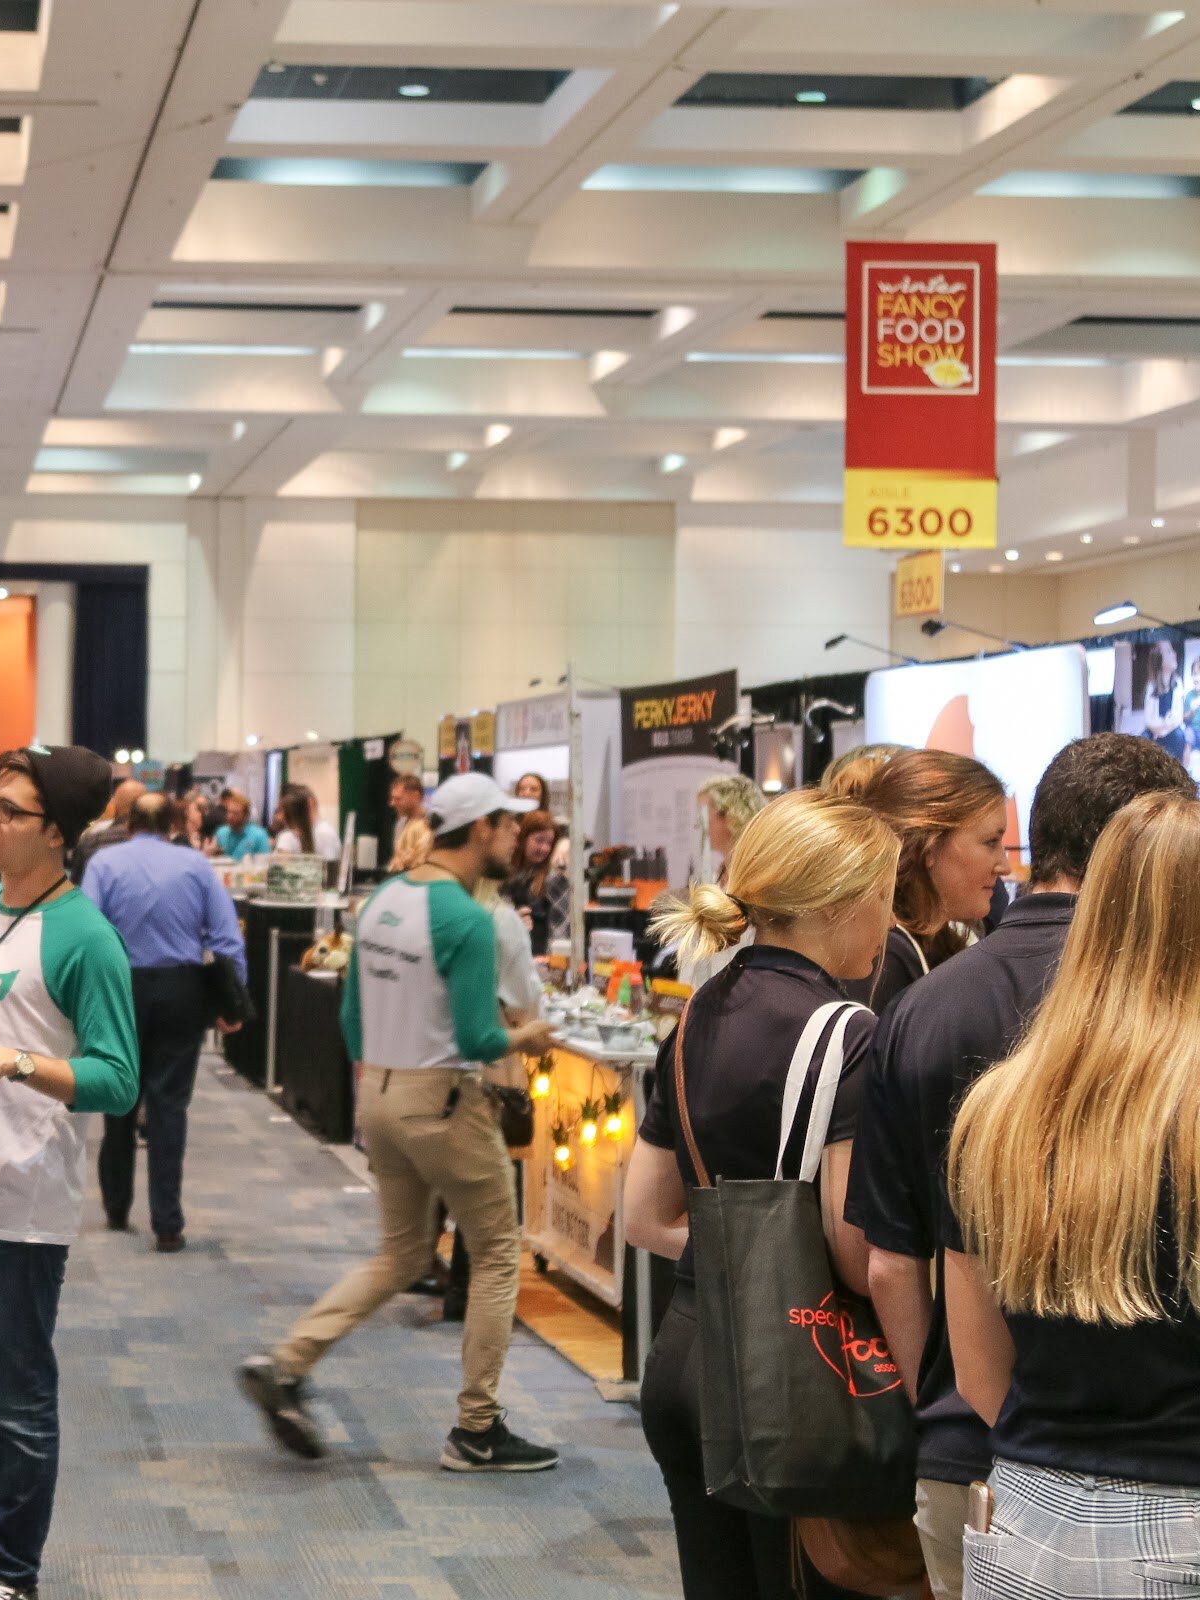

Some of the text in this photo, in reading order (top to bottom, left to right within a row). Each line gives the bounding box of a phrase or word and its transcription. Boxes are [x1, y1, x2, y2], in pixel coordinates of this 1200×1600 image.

[877, 293, 966, 319] FANCY
[877, 318, 966, 344] FOOD
[877, 342, 965, 368] SHOW
[867, 506, 973, 537] 6300
[788, 1308, 838, 1329] spec
[873, 1363, 897, 1373] asso
